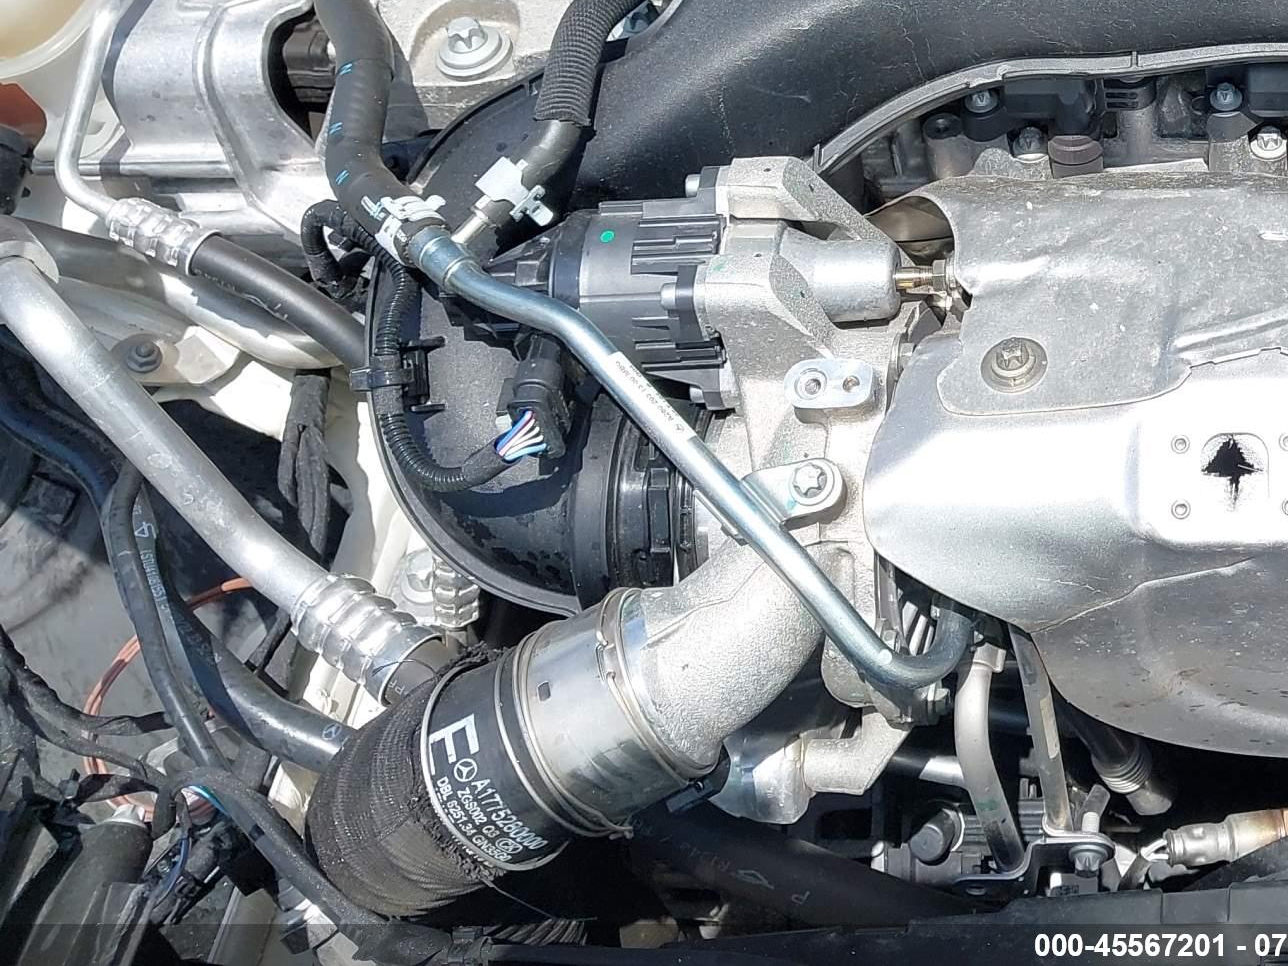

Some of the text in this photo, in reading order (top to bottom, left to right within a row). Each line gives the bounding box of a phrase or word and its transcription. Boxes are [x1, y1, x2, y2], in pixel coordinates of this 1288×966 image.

[429, 713, 480, 776] E
[436, 776, 454, 801] DBL
[446, 800, 477, 835] 6251.34
[456, 786, 488, 826] ZGS002
[481, 825, 500, 838] Q3
[470, 778, 549, 850] A1775280000
